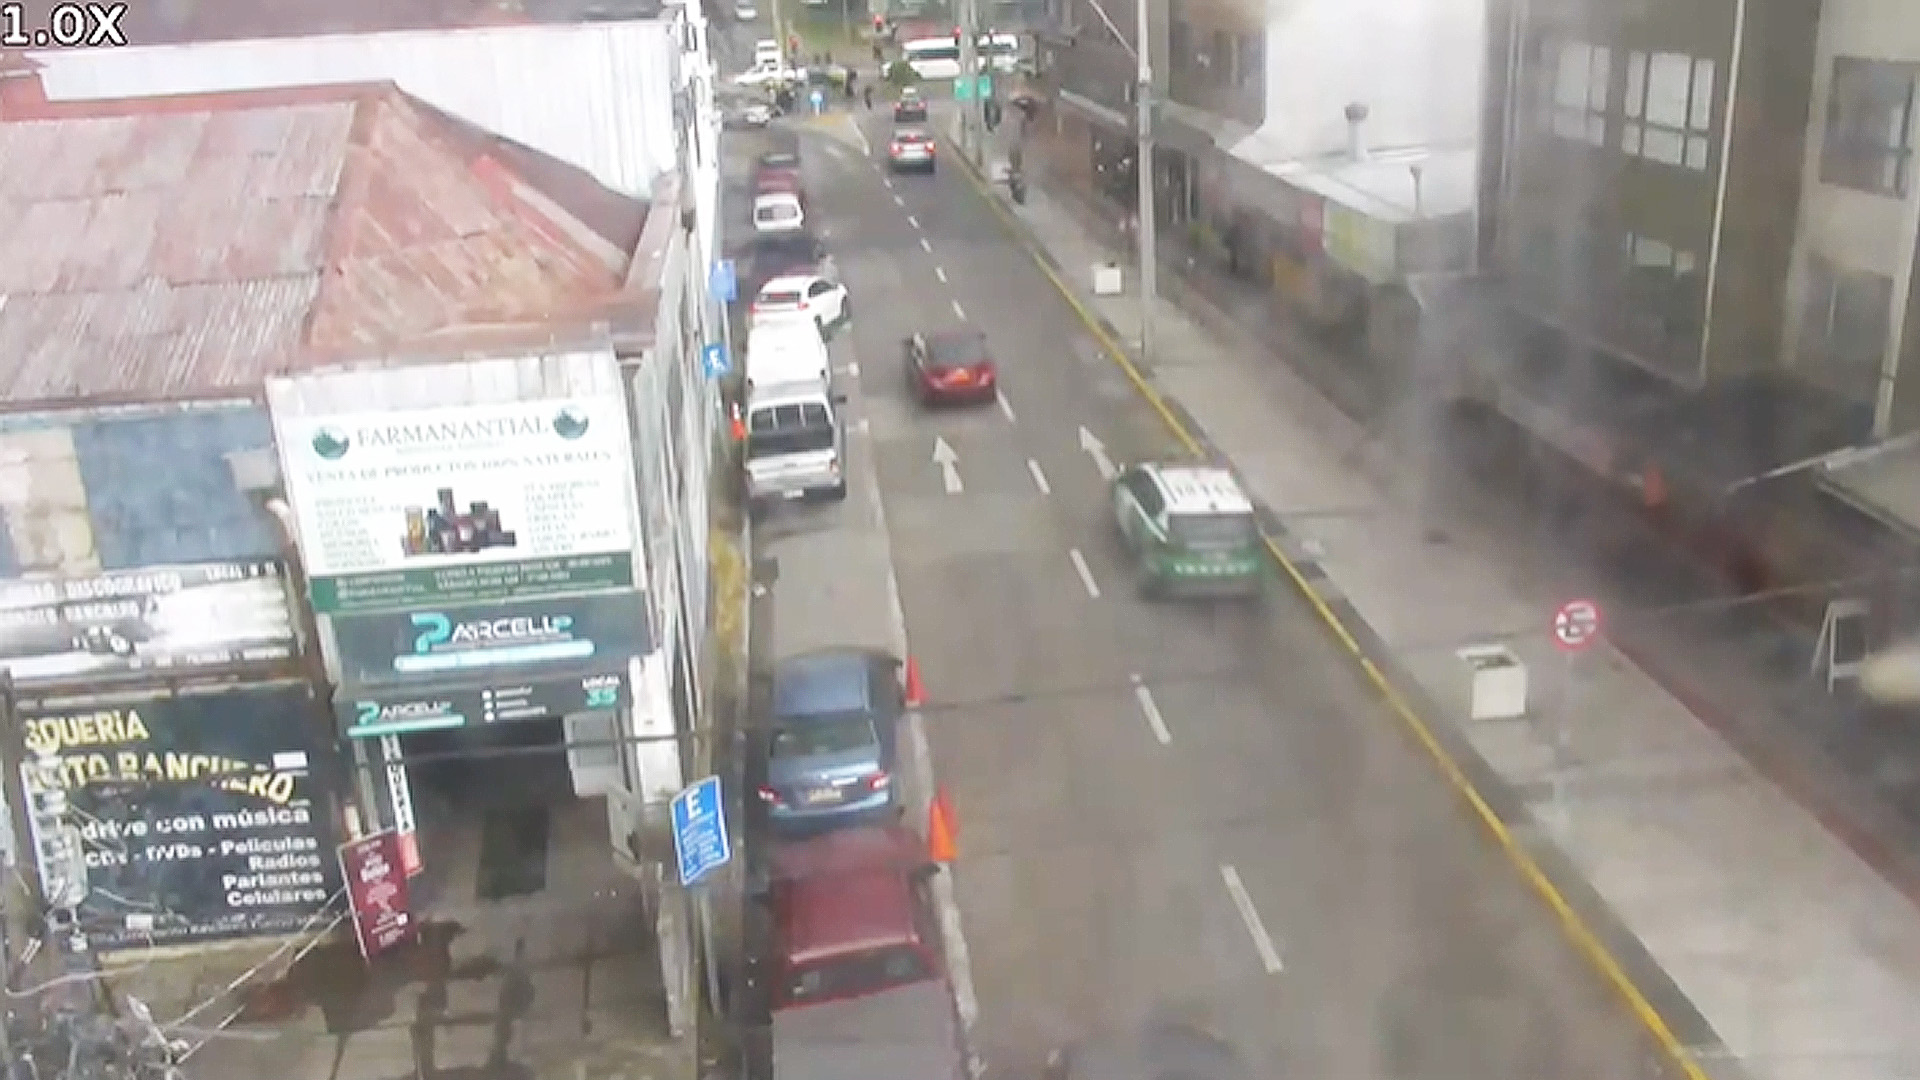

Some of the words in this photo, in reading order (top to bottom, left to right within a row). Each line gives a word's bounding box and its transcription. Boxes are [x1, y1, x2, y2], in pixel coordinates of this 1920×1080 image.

[356, 413, 549, 449] FARMANANTIAL
[212, 806, 310, 830] música
[248, 853, 321, 871] Radios
[226, 888, 327, 907] Celulares
